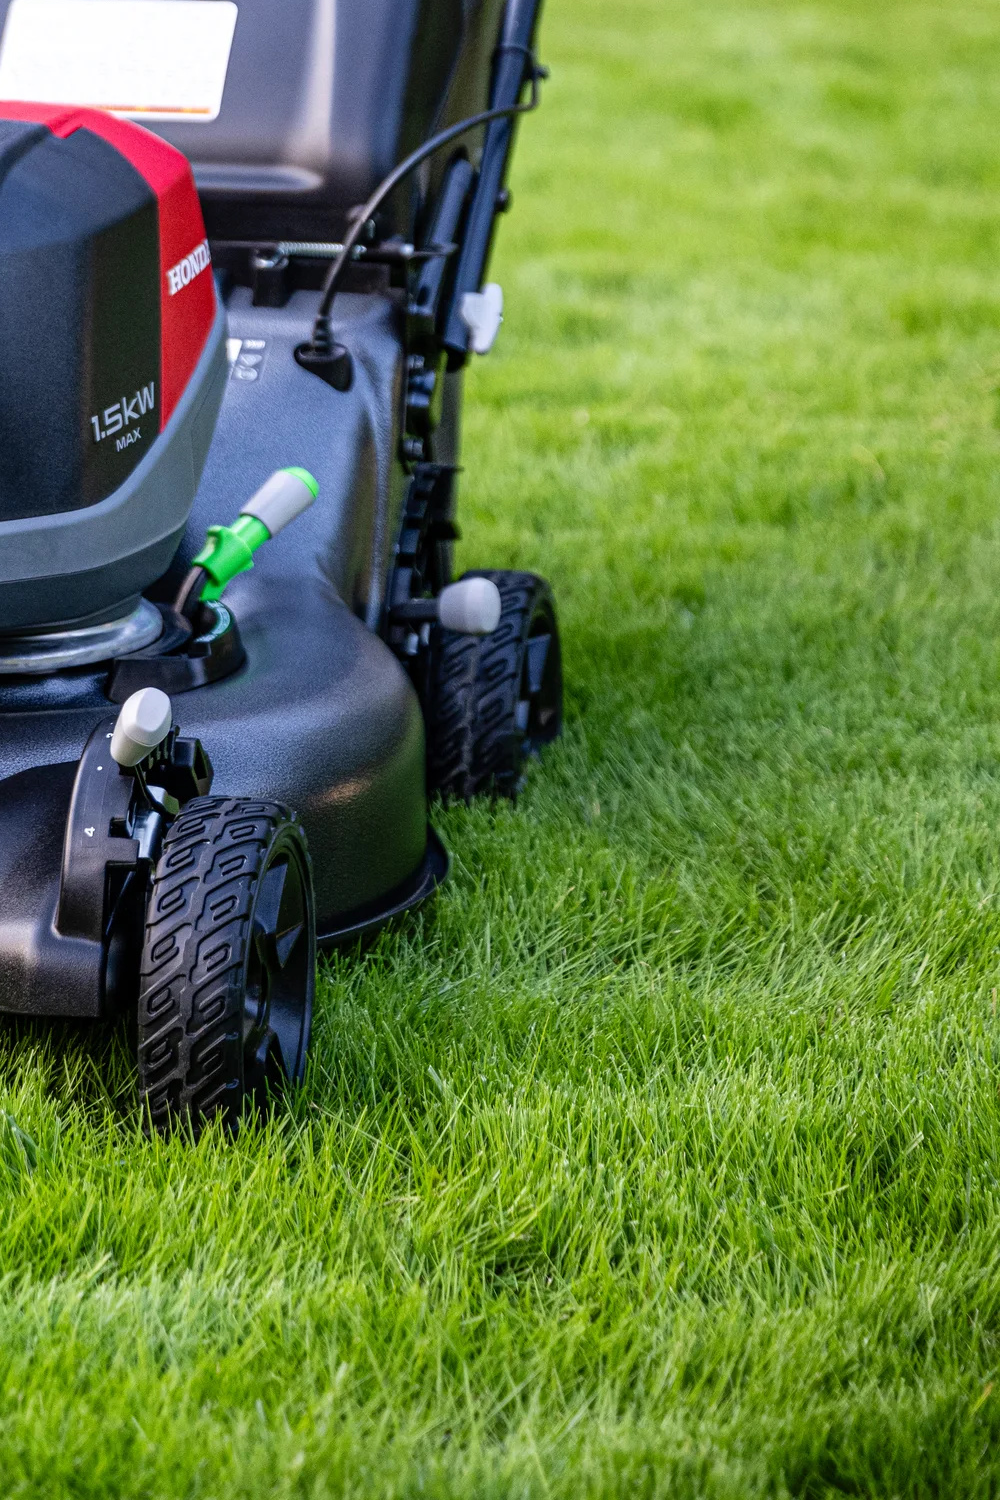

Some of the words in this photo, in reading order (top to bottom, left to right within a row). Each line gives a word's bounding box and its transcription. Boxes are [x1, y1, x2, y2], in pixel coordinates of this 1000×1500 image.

[91, 381, 155, 442] 1.5kW
[116, 426, 142, 452] MAX
[84, 826, 96, 838] 4
